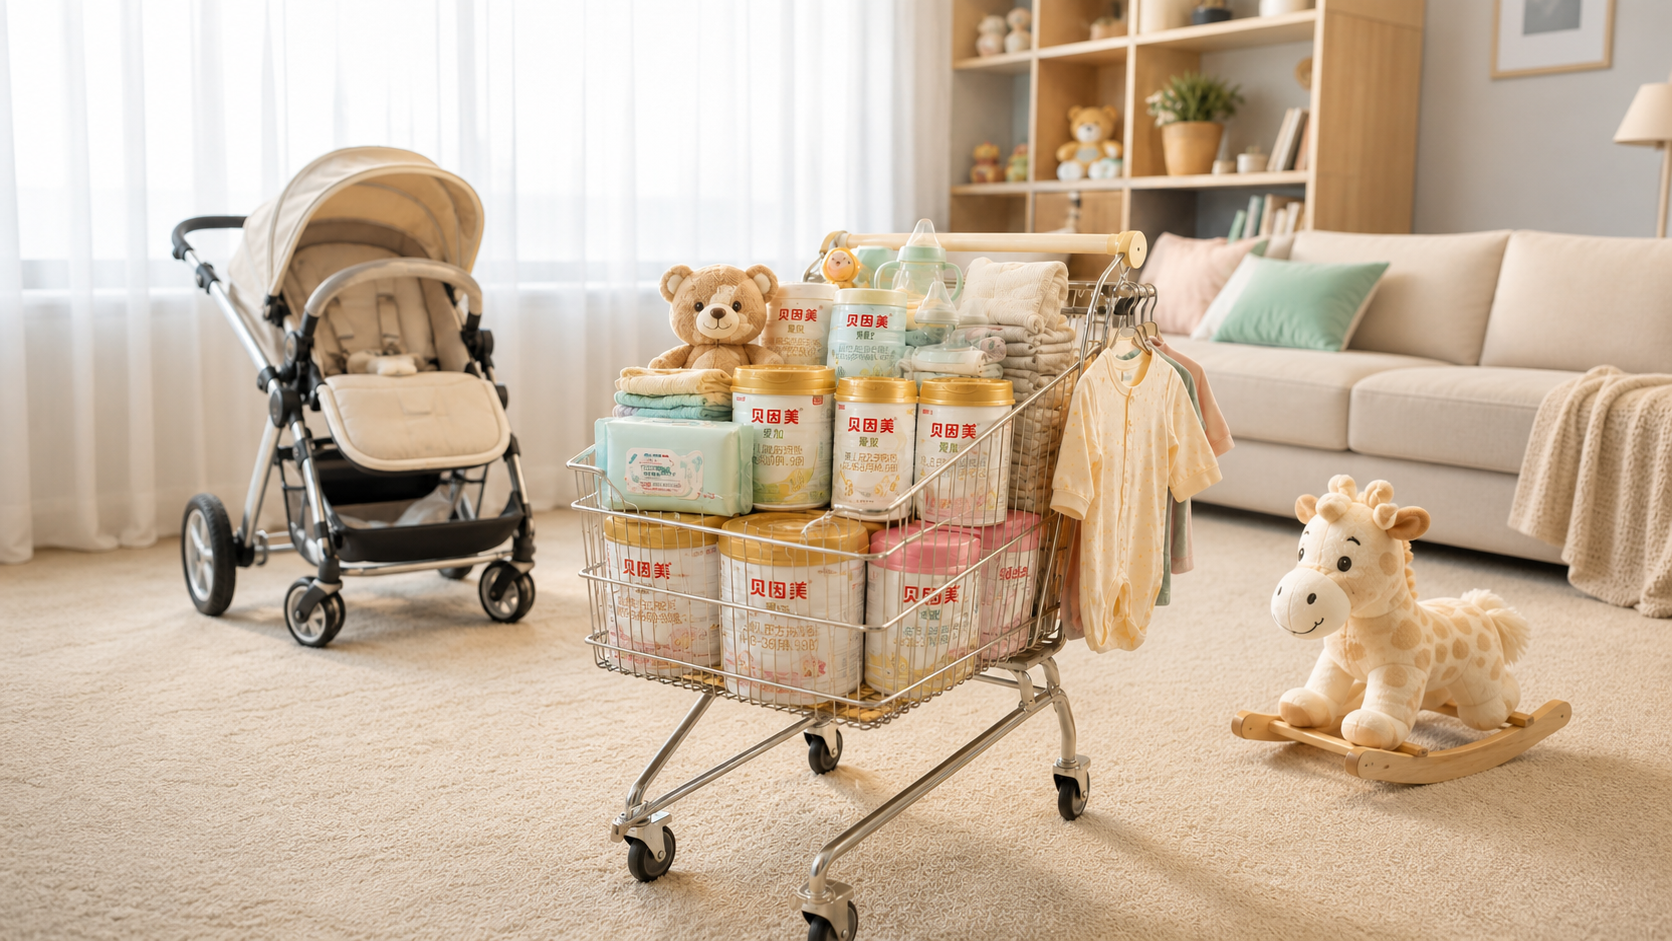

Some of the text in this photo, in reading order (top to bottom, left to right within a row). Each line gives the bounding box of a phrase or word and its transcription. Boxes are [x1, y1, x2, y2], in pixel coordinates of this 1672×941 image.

[779, 308, 817, 322] 贝因美
[846, 314, 888, 329] 贝因美
[752, 408, 799, 425] 贝因美
[847, 417, 894, 433] 贝因美
[930, 422, 977, 439] 贝因美
[623, 559, 671, 579] 贝因美
[750, 578, 807, 600] 贝因美
